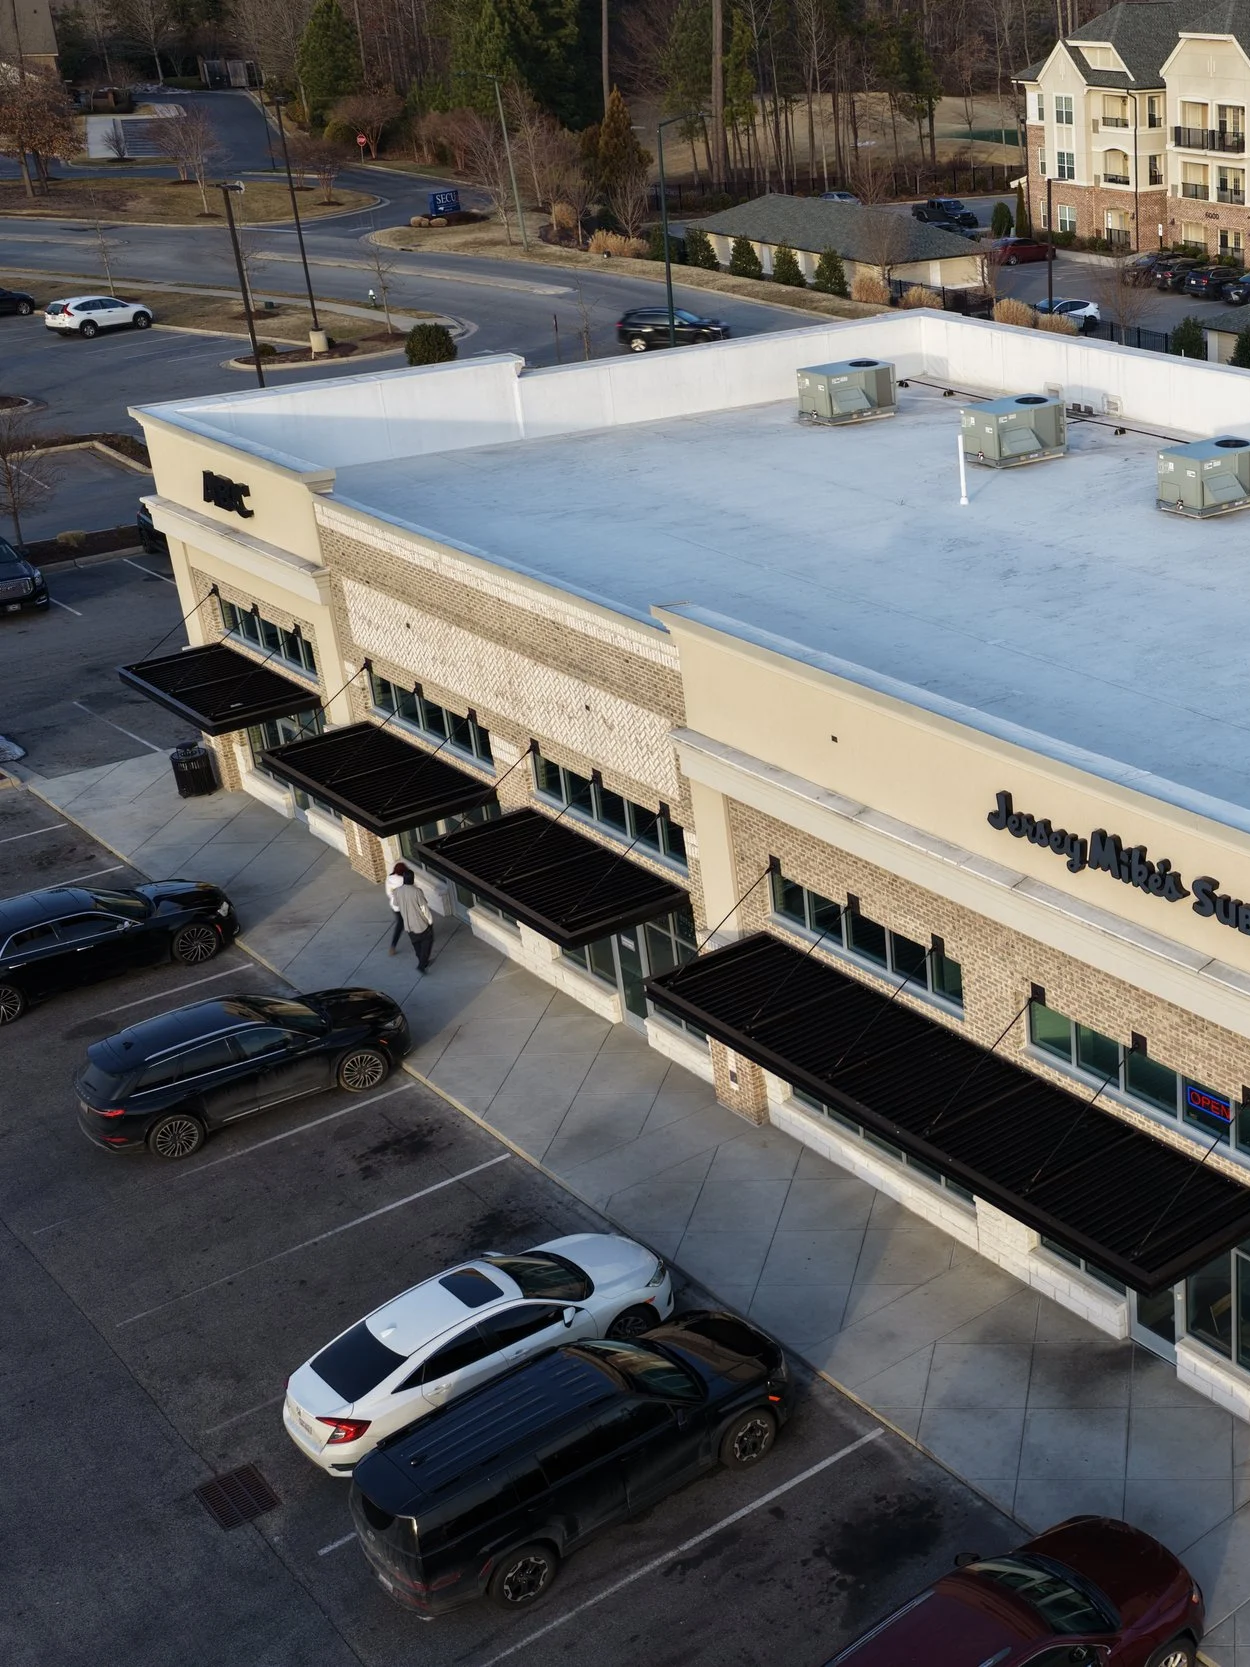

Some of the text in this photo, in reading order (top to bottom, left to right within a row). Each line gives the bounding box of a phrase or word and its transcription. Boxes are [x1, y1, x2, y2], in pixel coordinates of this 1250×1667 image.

[987, 790, 1088, 873] Jersey
[1087, 828, 1190, 902] Mike's
[1190, 1091, 1230, 1120] OPEN
